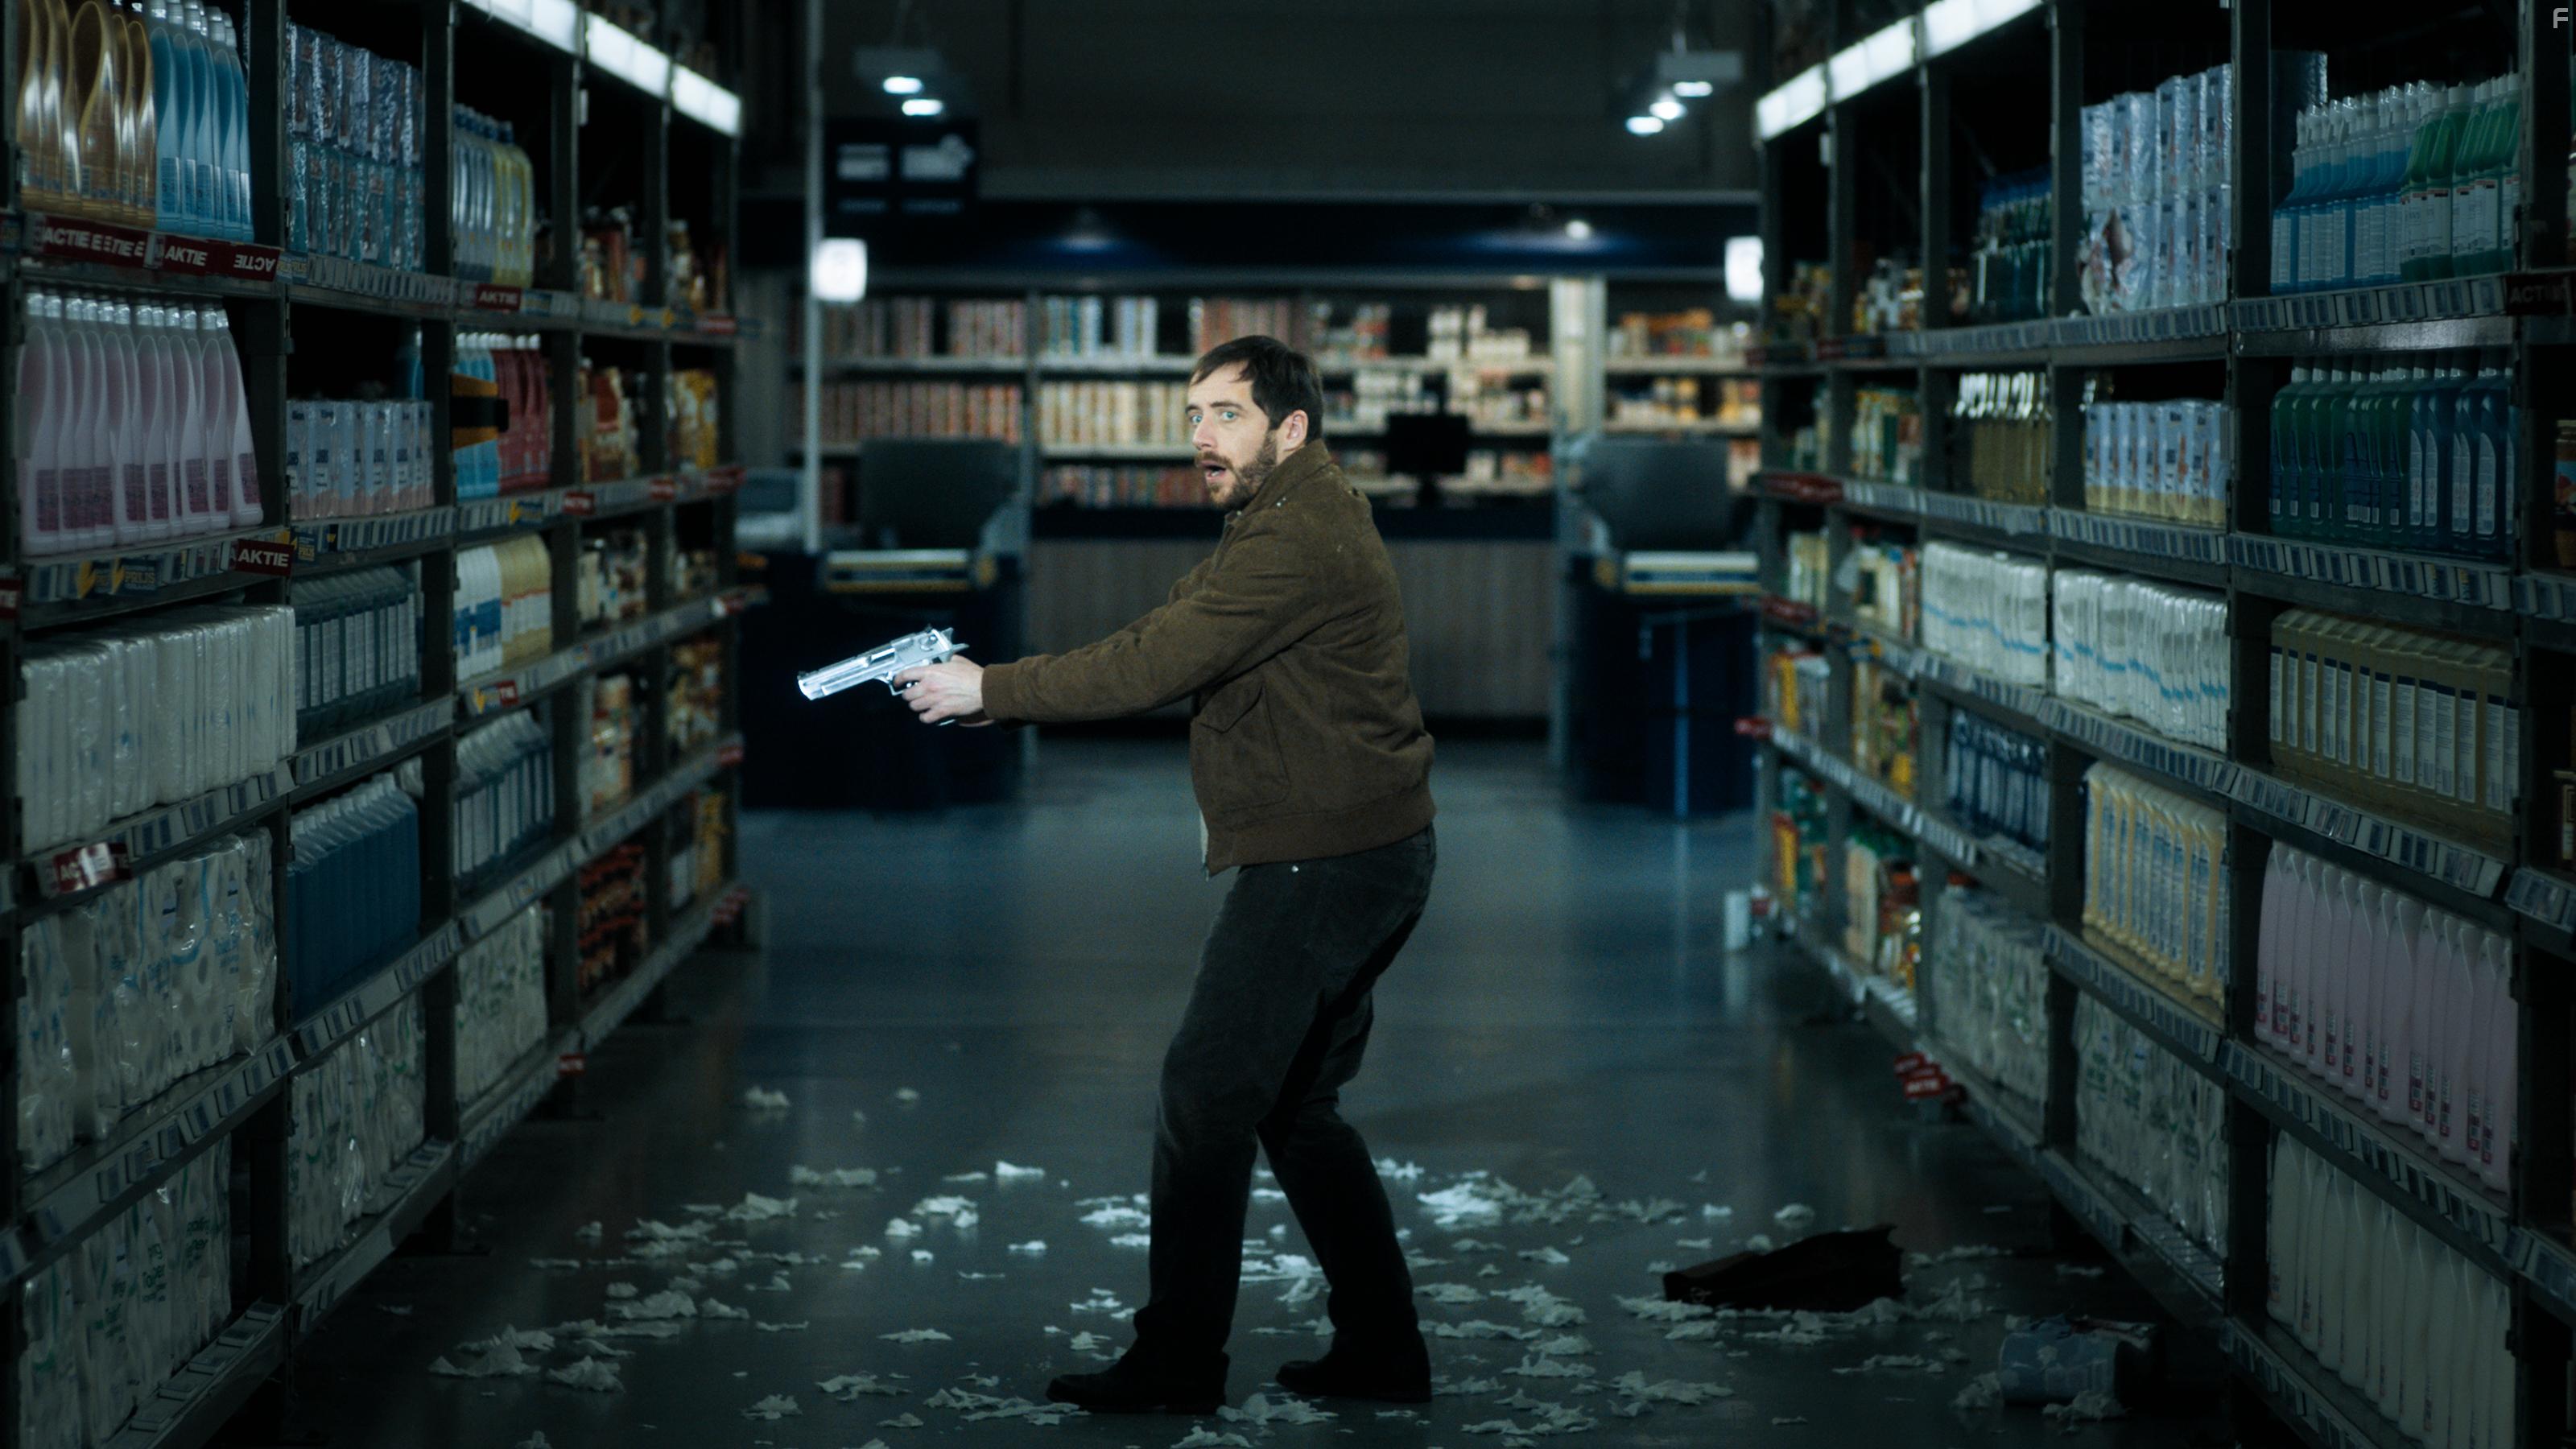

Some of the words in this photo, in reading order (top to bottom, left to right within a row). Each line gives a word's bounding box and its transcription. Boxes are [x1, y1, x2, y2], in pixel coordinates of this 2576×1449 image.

[164, 245, 208, 266] AKTIE
[233, 254, 276, 273] ACTIE
[237, 548, 291, 568] AKTIE
